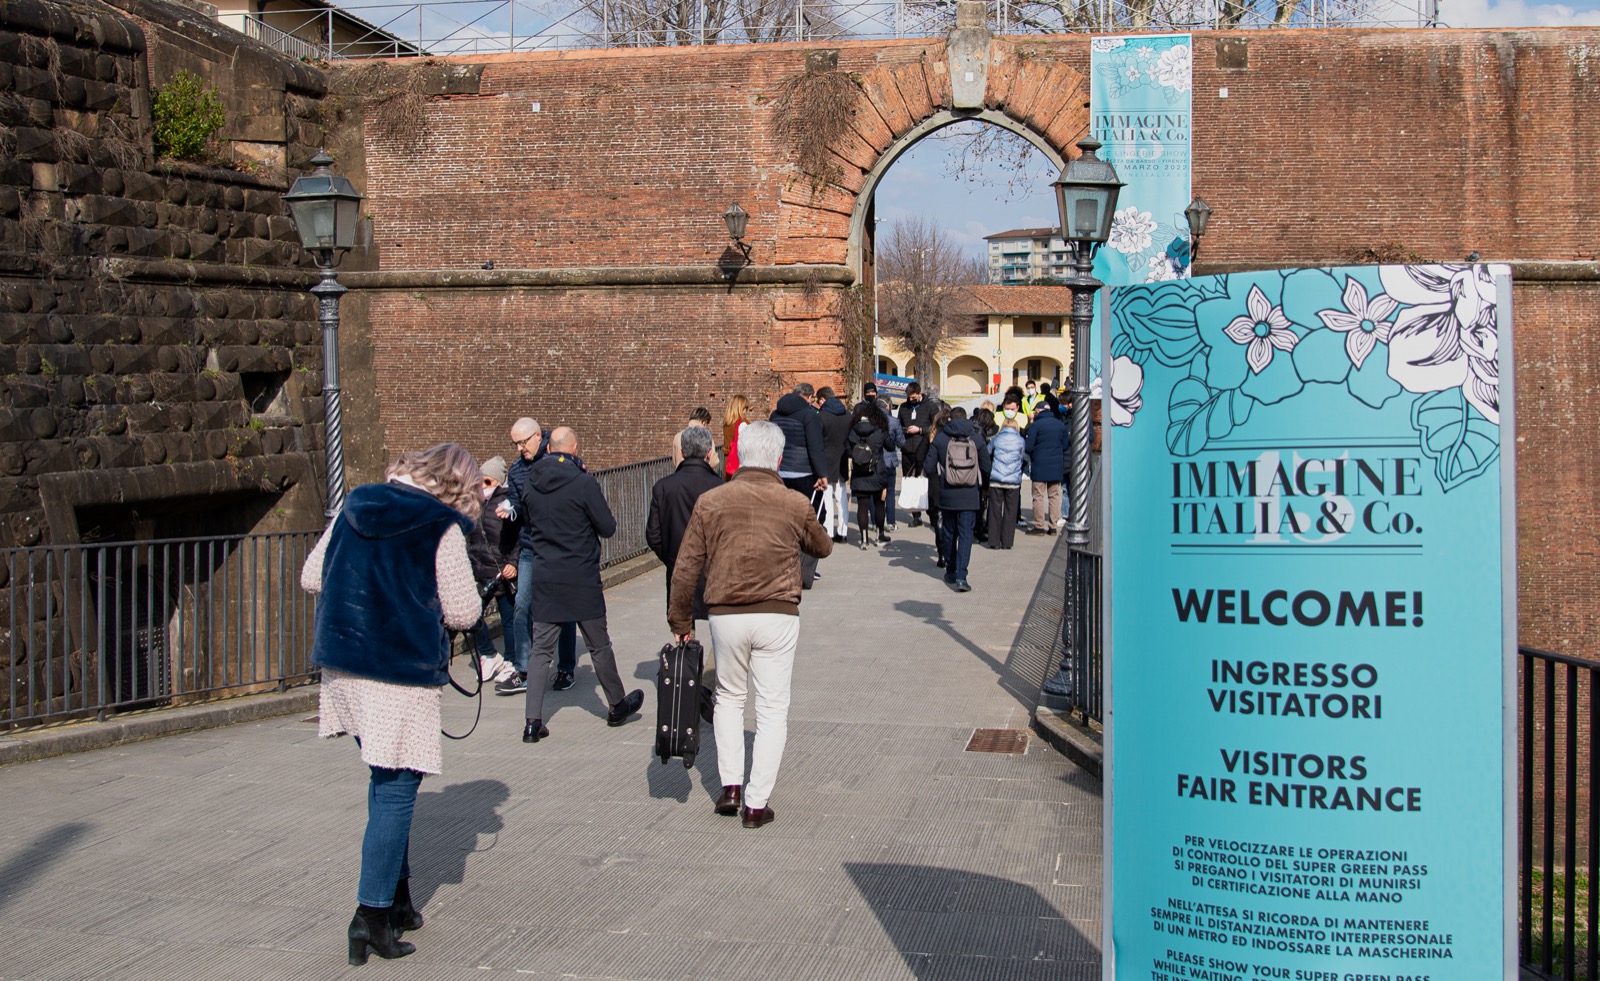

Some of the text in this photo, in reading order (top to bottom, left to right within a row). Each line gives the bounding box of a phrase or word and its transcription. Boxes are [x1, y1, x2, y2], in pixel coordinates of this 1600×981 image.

[1095, 115, 1188, 128] IMMAGINE
[1095, 129, 1188, 141] ITALIA & Co.
[1170, 457, 1423, 499] IMMAGINE
[1170, 500, 1423, 535] ITALIA & Co.
[1171, 588, 1424, 628] WELCOME!
[1211, 659, 1378, 688] INGRESSO
[1207, 688, 1382, 719] VISITATORI
[1220, 748, 1367, 780] VISITORS
[1177, 773, 1421, 812] FAIR ENTRANCE
[1172, 846, 1428, 876] DI CONTROLLO DEL SUPER GREEN PASS
[1185, 835, 1407, 862] PER VELOCIZZARE LE OPERAZIONI
[1174, 859, 1421, 890] SI PREGANO I VISITATORI DI MUNIRSI
[1192, 875, 1403, 903] DI CERTIFICAZIONE ALLA MANO
[1151, 906, 1453, 945] SEMPRE IL DISTANZIAMENTO INTERPERSONALE
[1168, 897, 1429, 931] NELL'ATTESA SI RICORDA DI MANTENERE
[1154, 920, 1453, 959] DI UN METRO ED INDOSSARE LA MASCHERINA
[1153, 959, 1186, 975] WHILE
[1167, 949, 1205, 966] PLEASE
[1208, 957, 1248, 974] SHOW
[1253, 964, 1290, 979] YOUR
[1295, 969, 1338, 981] SUPER
